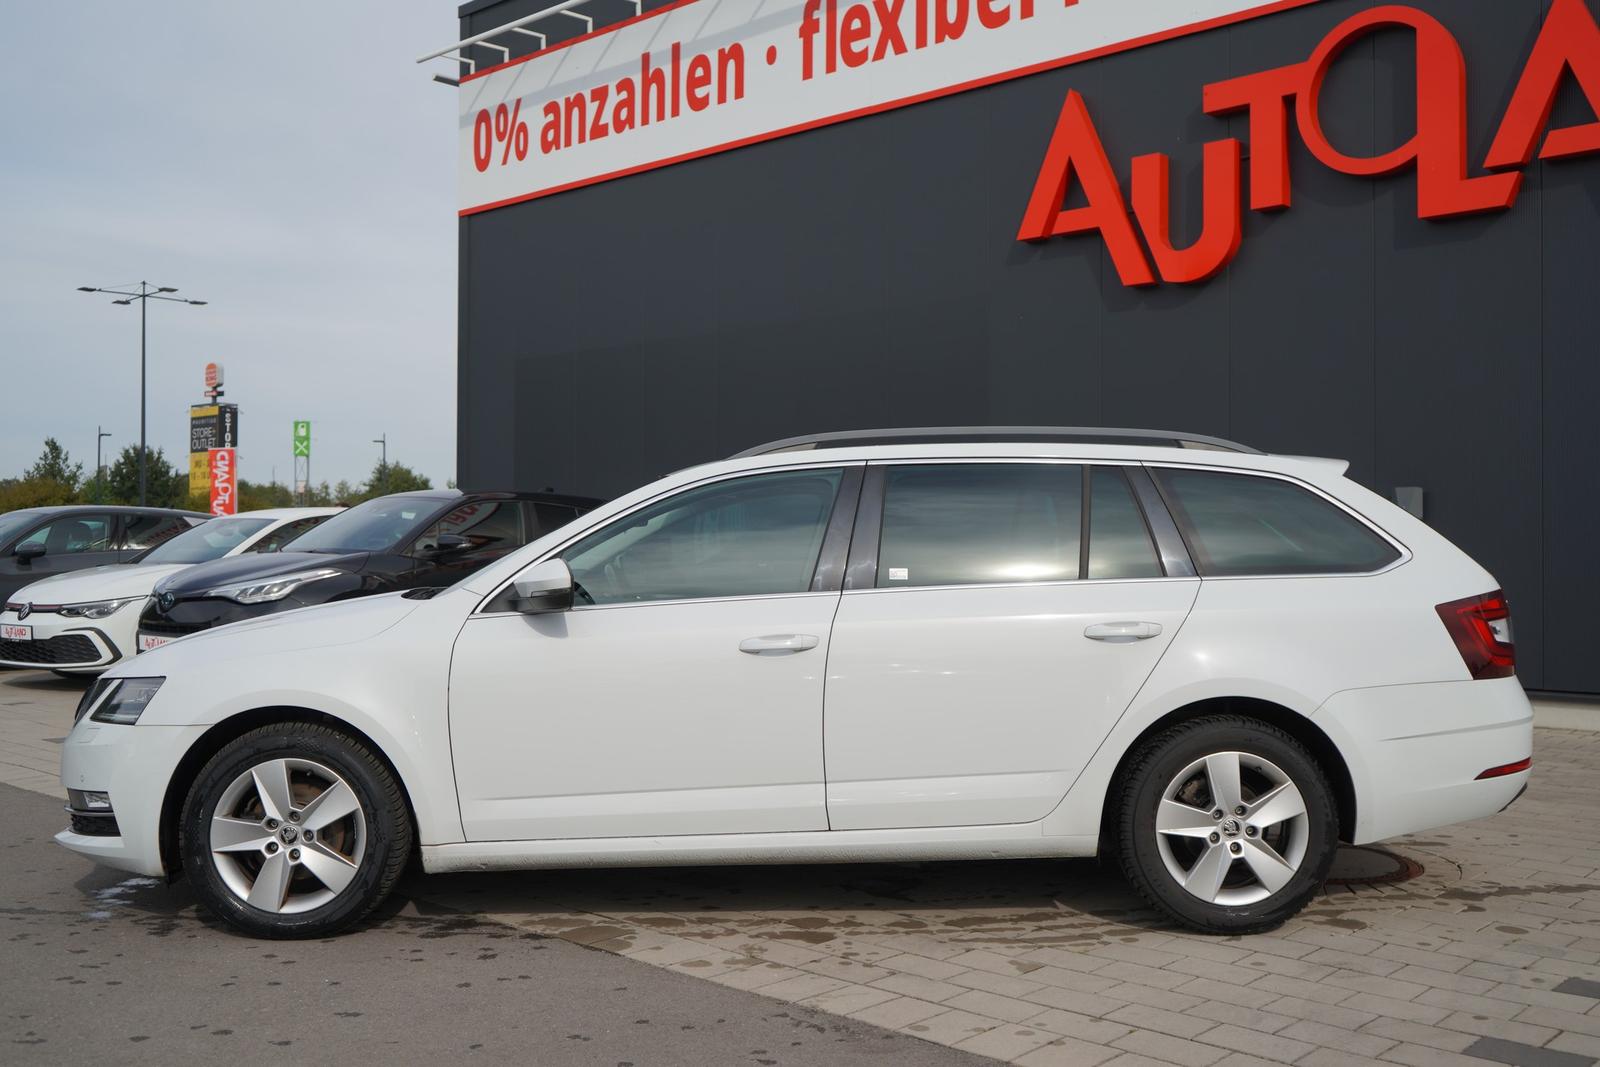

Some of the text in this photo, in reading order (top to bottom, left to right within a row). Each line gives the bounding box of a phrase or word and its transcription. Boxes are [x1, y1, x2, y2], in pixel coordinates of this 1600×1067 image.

[473, 0, 1034, 172] 0% anzahlen flexi
[192, 437, 216, 449] OUTLET
